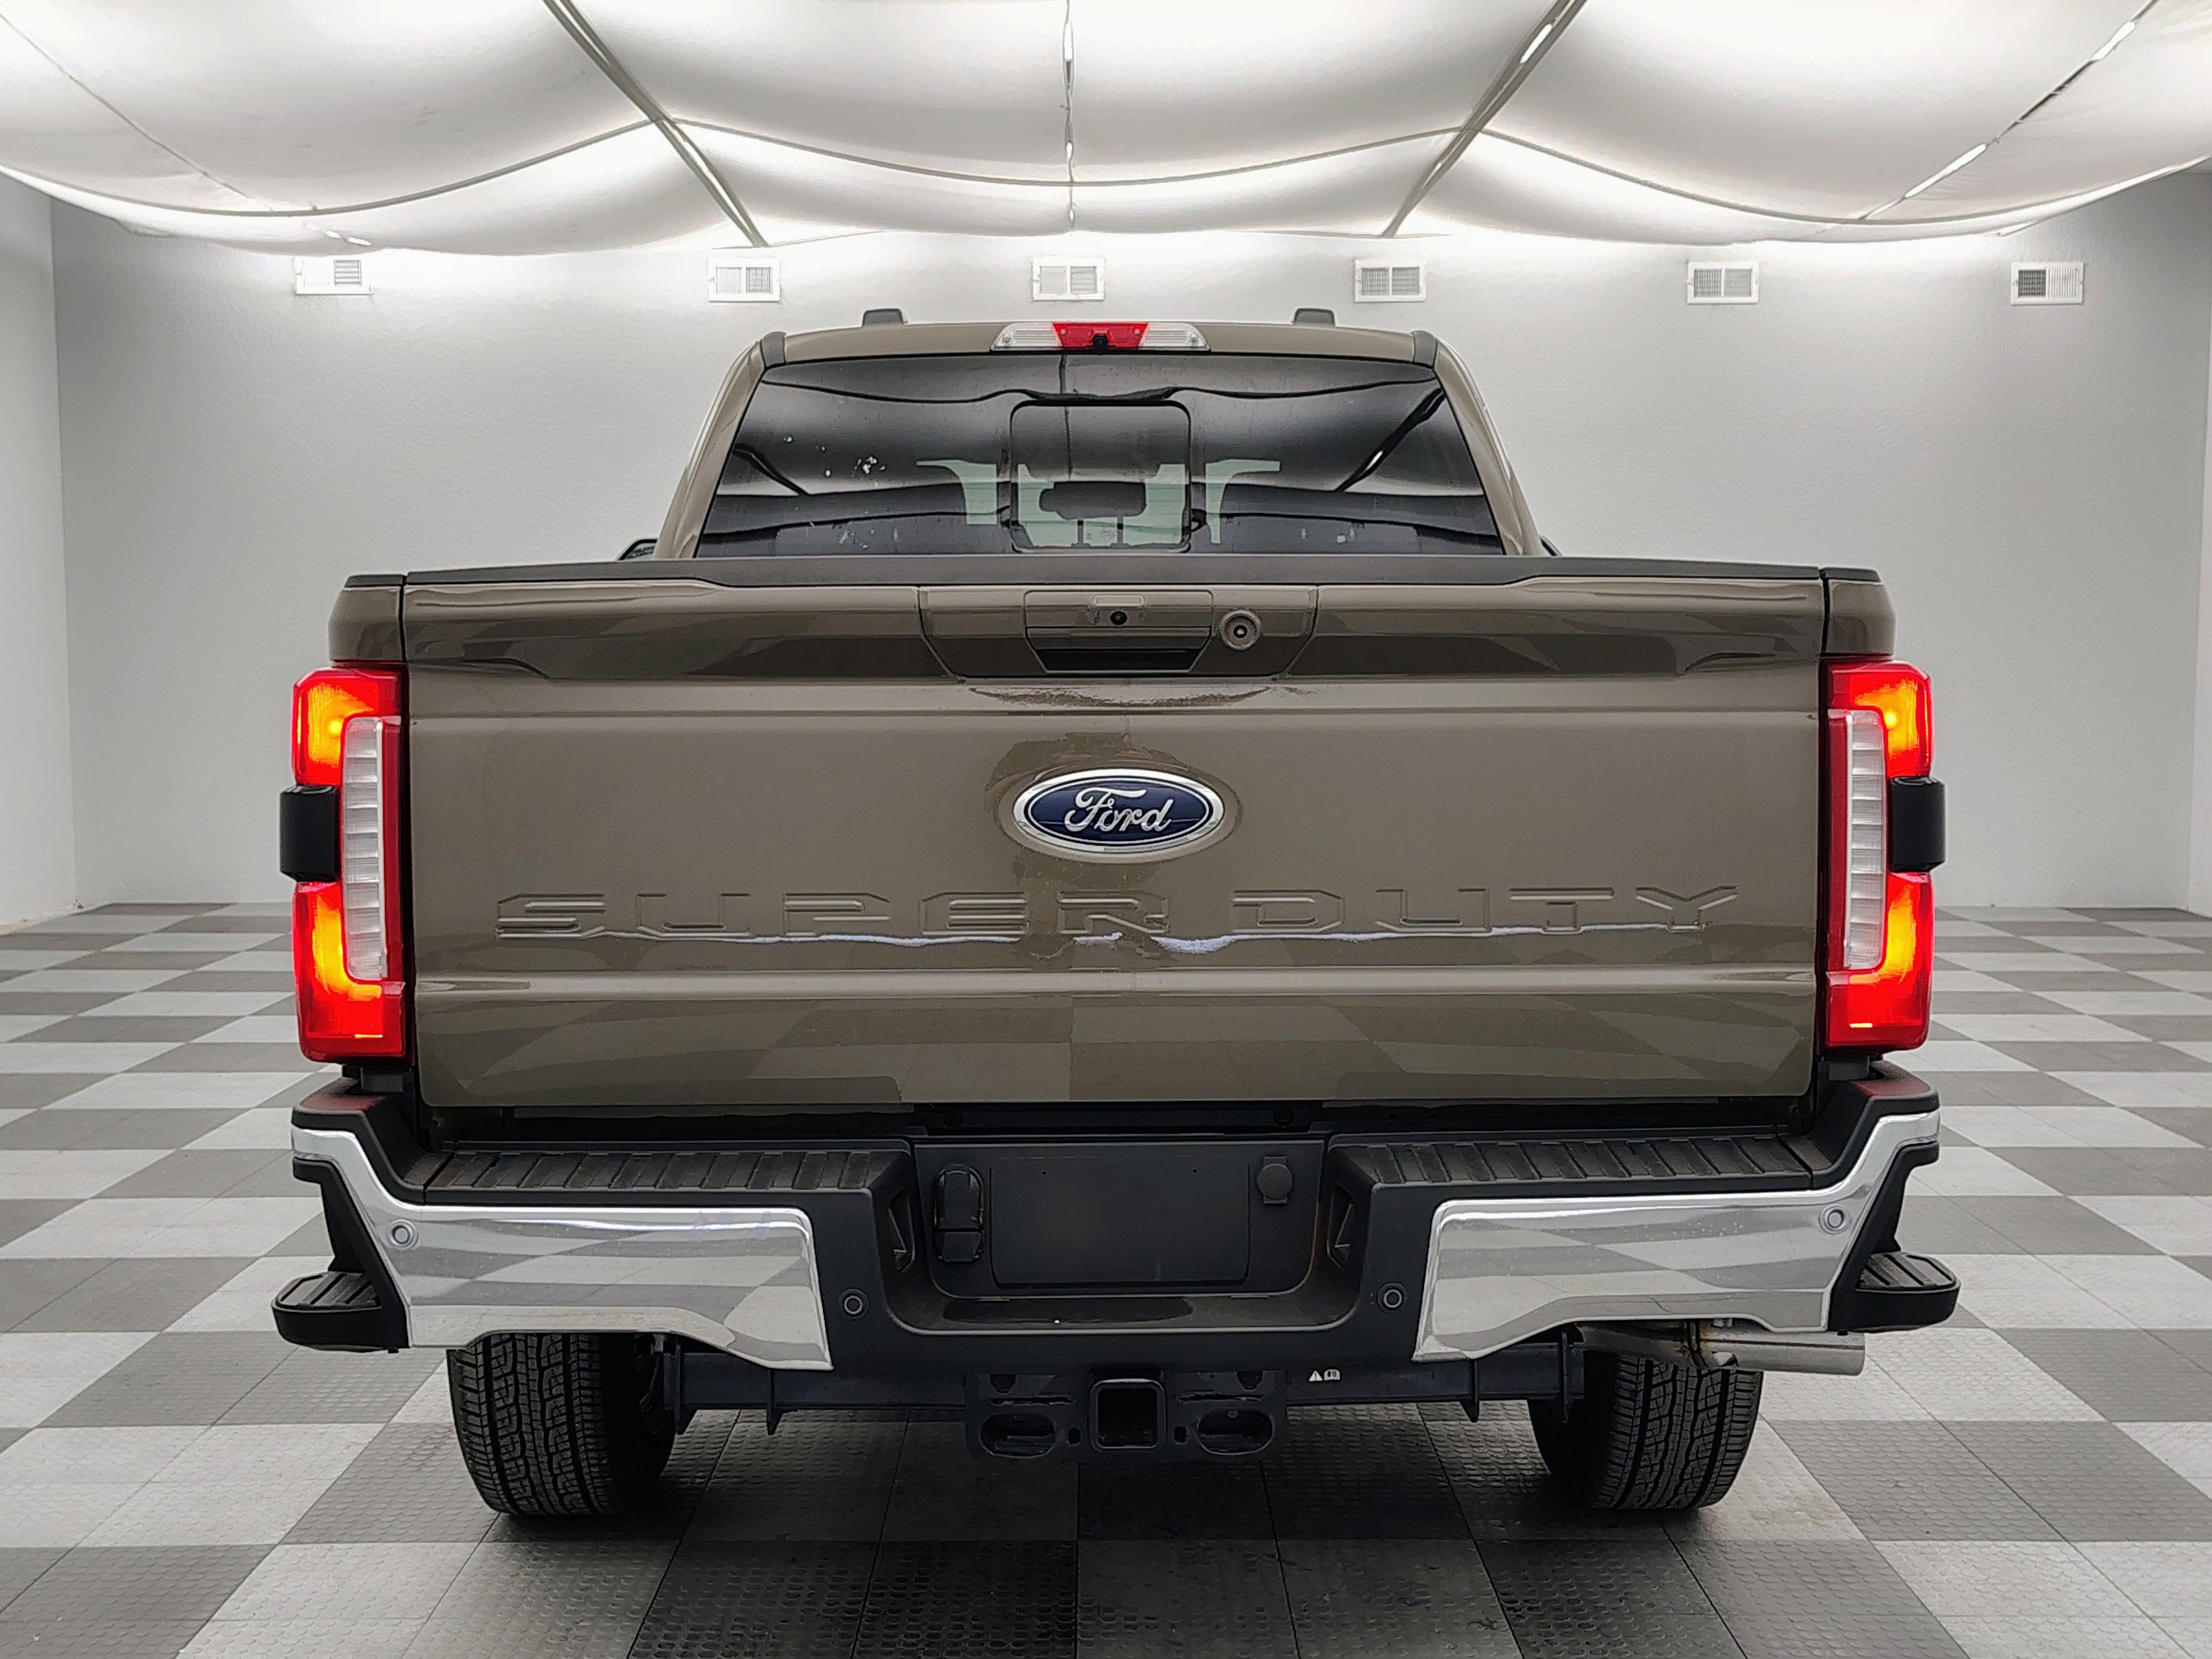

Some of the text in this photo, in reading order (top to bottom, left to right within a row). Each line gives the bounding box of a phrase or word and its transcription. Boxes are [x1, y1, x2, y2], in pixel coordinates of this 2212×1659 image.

[1063, 786, 1175, 833] Ford
[496, 886, 1739, 940] SUPER DUTY
